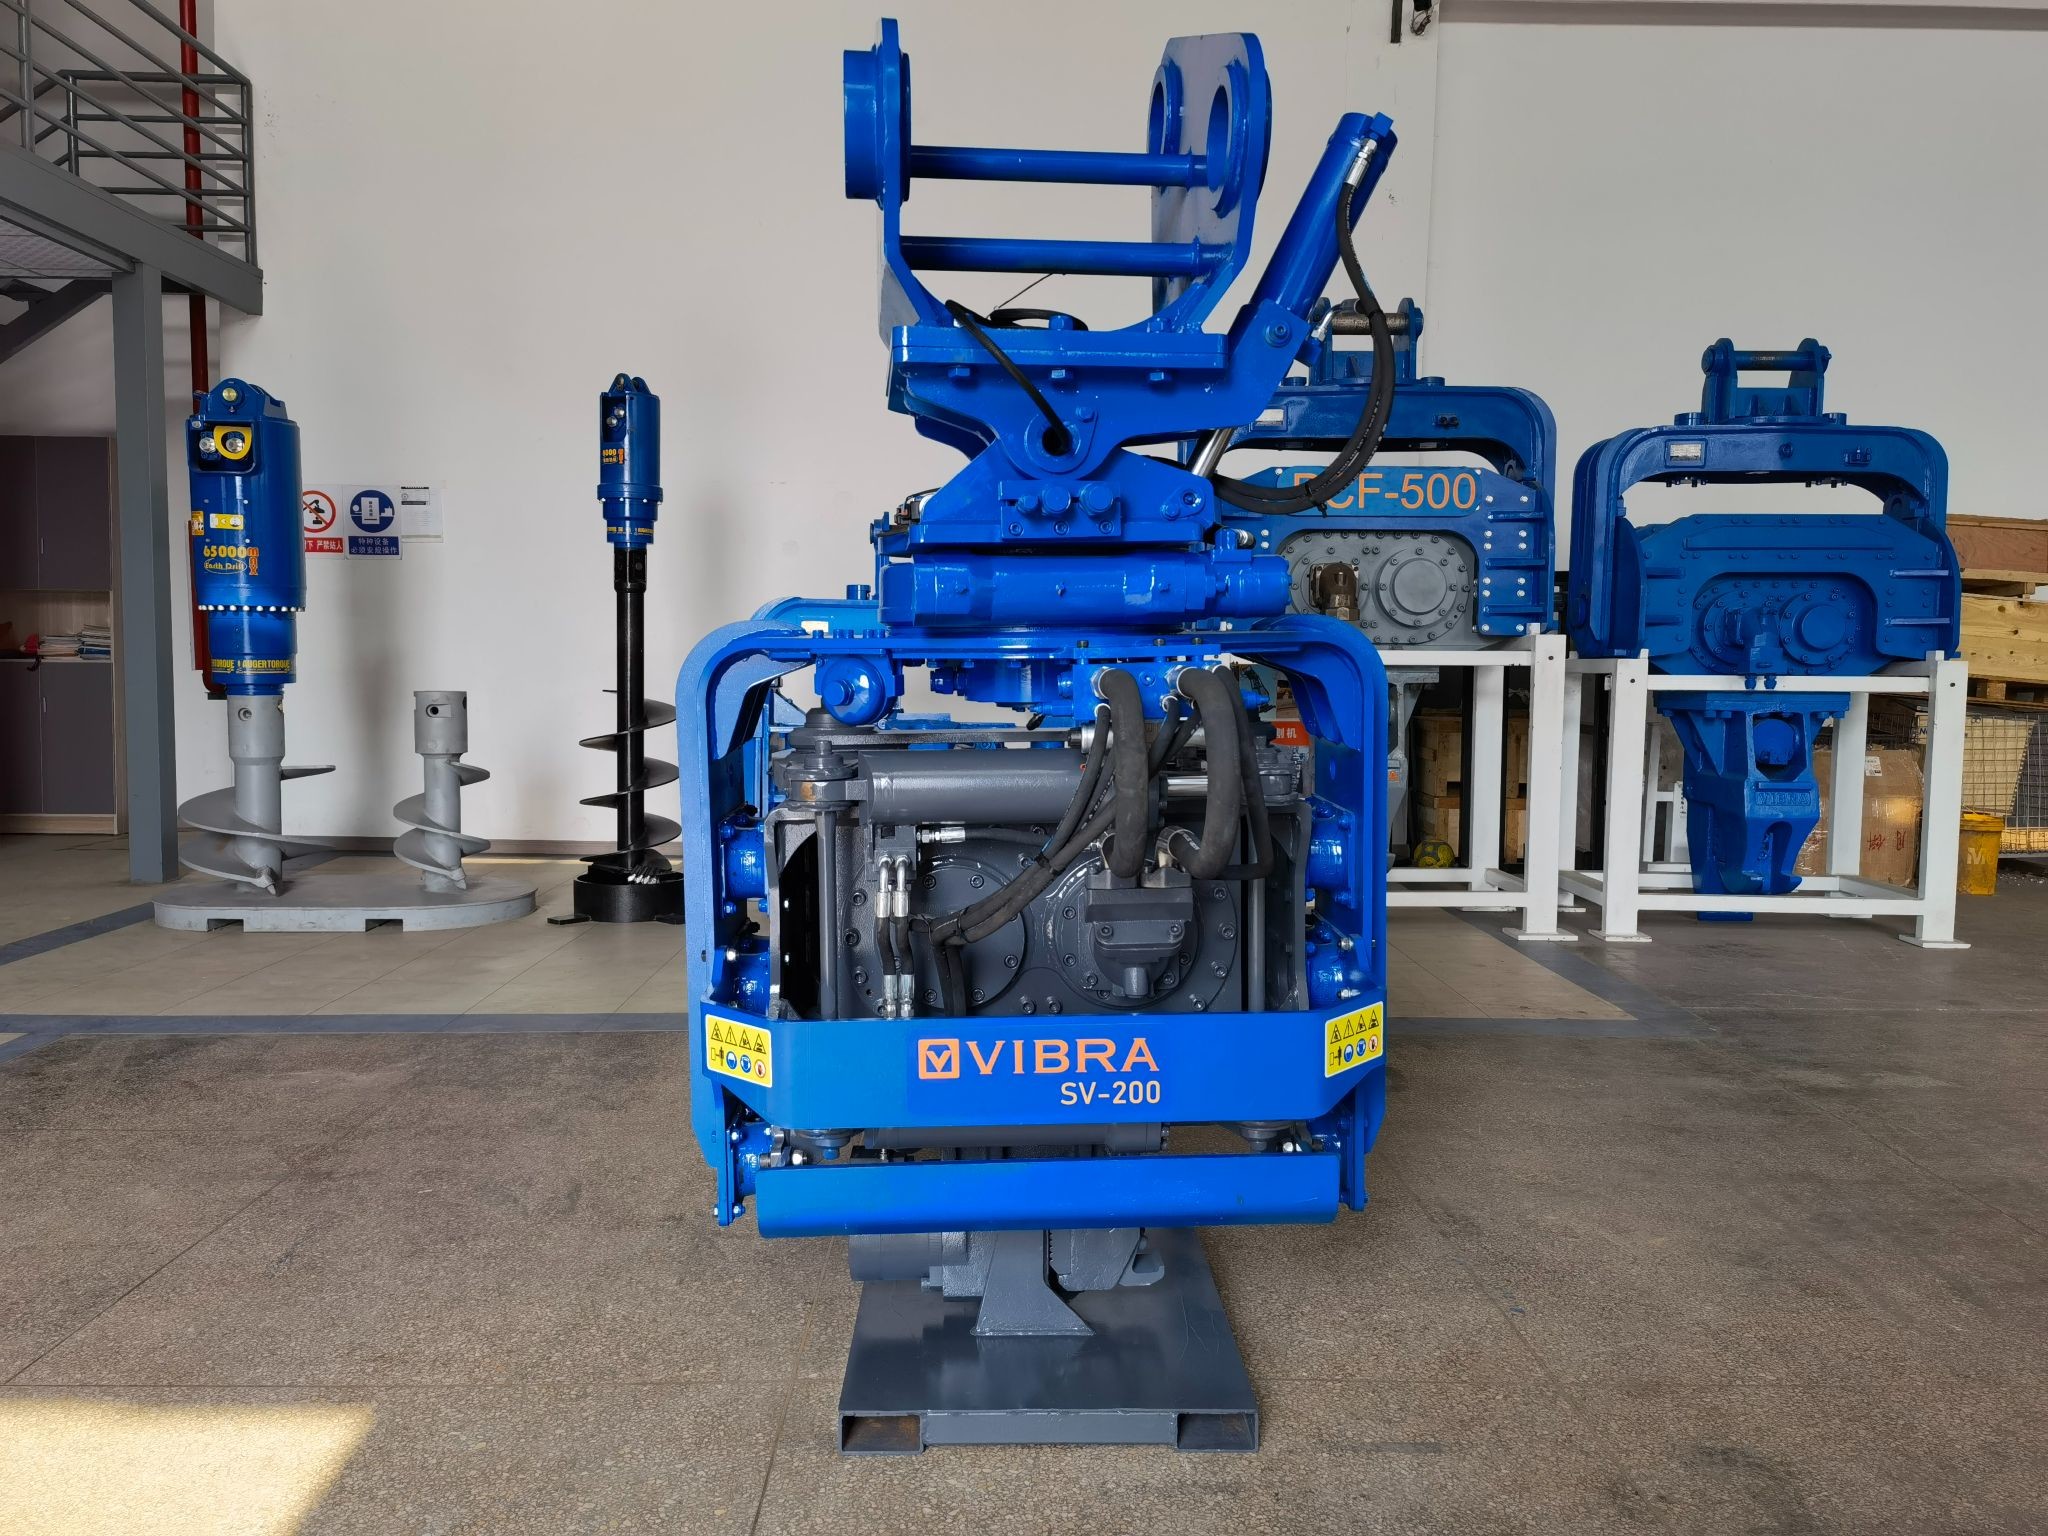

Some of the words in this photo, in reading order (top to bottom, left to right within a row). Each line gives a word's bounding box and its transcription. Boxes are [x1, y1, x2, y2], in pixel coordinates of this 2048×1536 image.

[316, 539, 343, 551] 严禁站人
[358, 536, 389, 546] 特种设备
[203, 545, 247, 559] 65000
[965, 1037, 1160, 1075] VIBRA
[1060, 1080, 1161, 1106] SV-200
